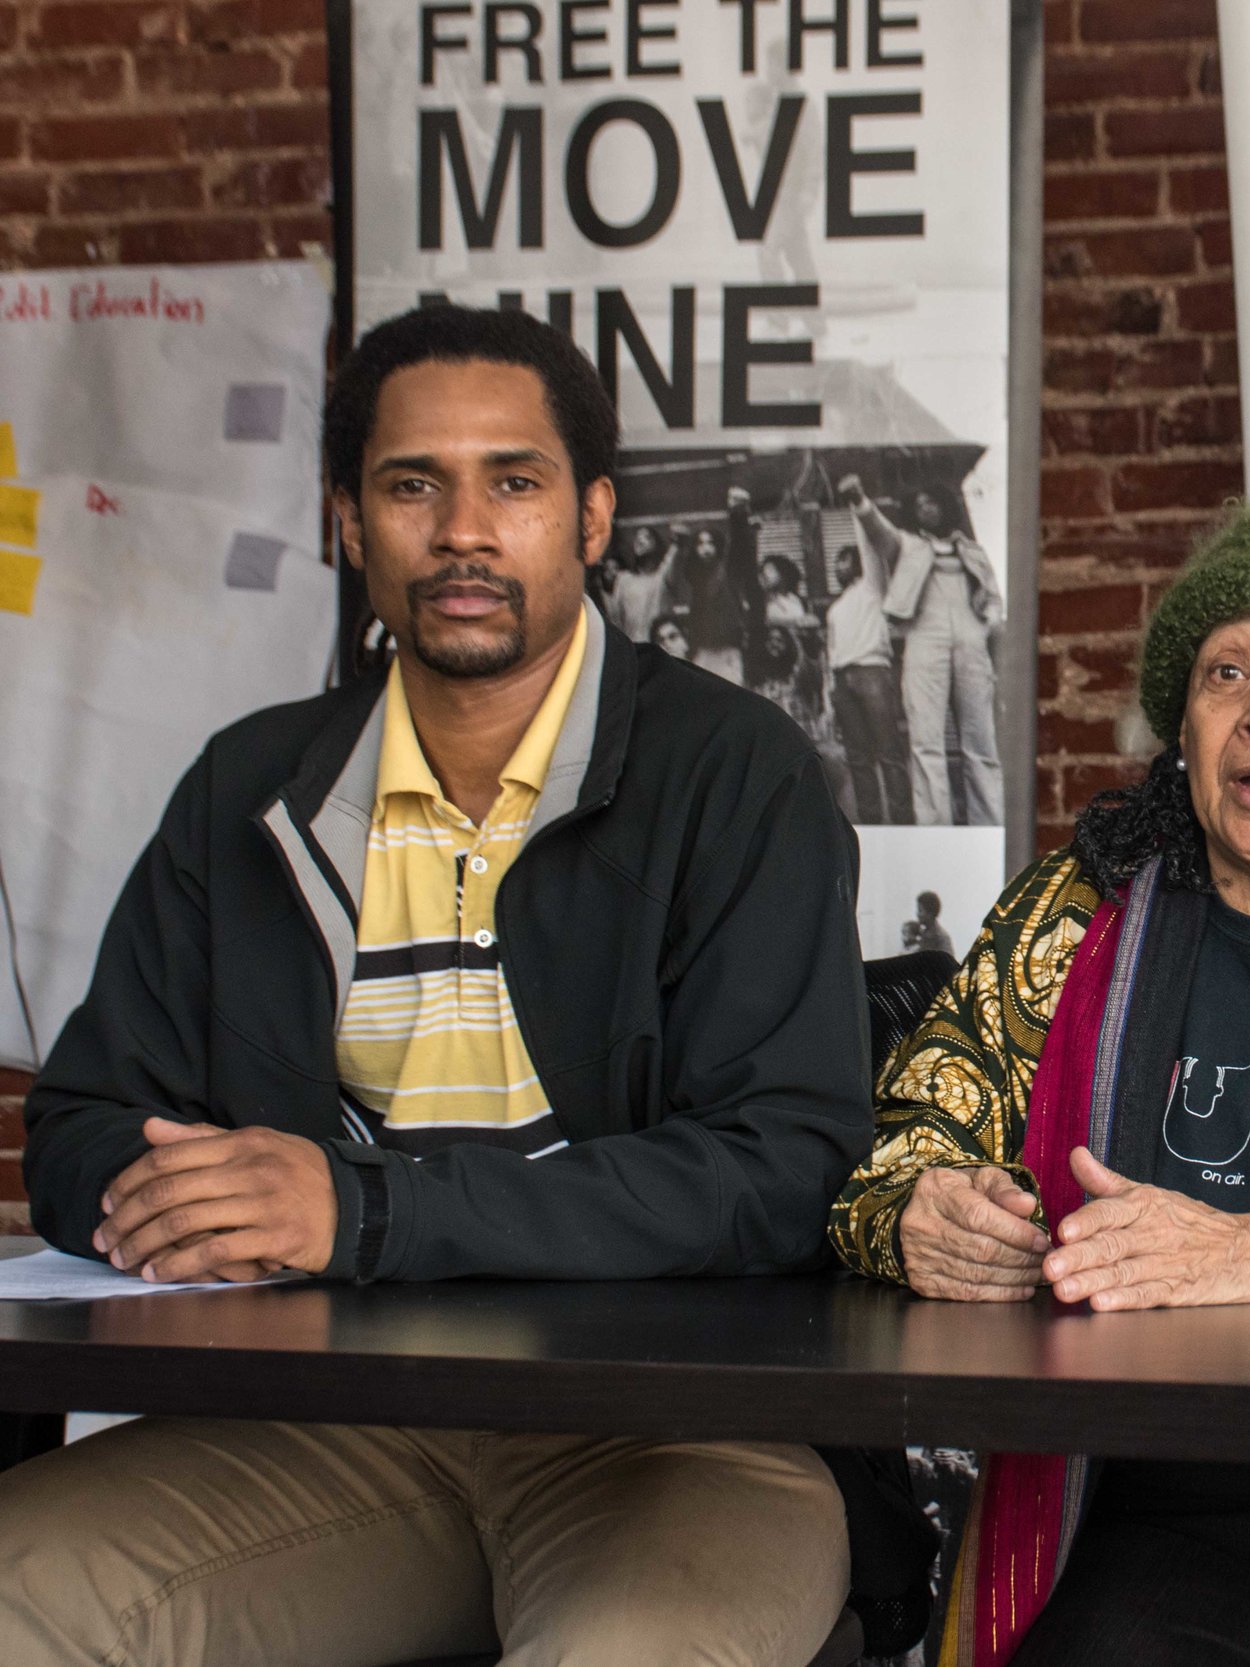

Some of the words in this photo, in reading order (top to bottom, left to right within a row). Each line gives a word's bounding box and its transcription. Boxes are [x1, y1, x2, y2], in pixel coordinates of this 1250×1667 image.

[420, 0, 681, 85] FREE
[718, 0, 924, 74] THE
[417, 89, 925, 251] MOVE
[417, 283, 823, 429] NE
[1201, 1169, 1222, 1184] on
[1224, 1173, 1245, 1186] air.
